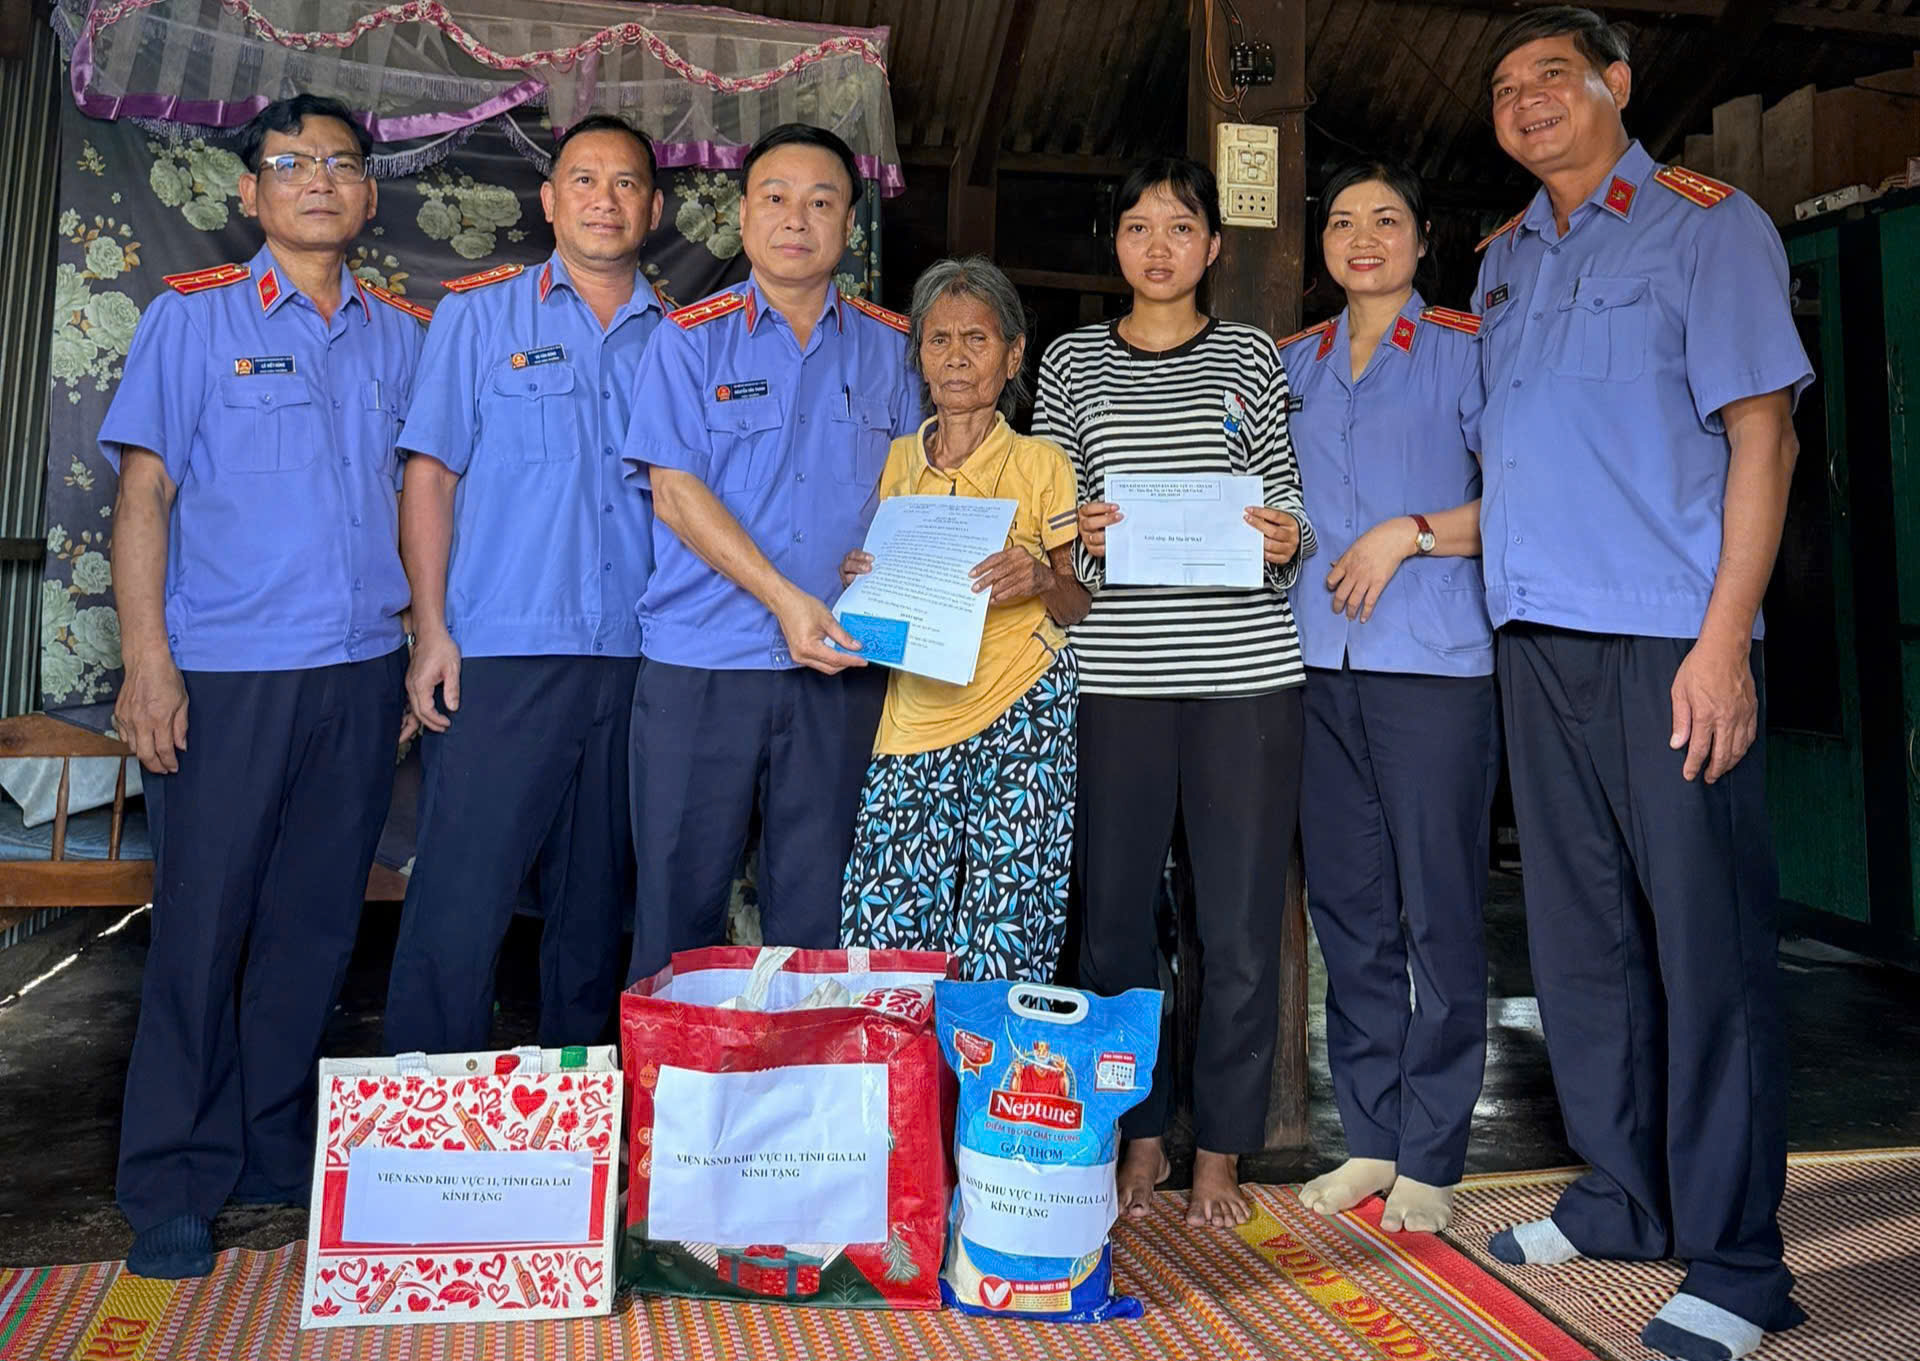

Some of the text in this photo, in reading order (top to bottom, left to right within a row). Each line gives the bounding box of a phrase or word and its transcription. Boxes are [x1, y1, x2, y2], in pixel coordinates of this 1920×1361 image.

[995, 1095, 1076, 1125] Neptune
[677, 1154, 701, 1165] VIỆN
[703, 1157, 731, 1166] KSND
[734, 1154, 756, 1163] KHU
[759, 1153, 782, 1165] VỰC
[784, 1153, 797, 1163] 11,
[827, 1153, 846, 1162] GIA
[848, 1153, 867, 1162] LAI
[378, 1173, 402, 1185] VIỆN
[405, 1174, 433, 1185] KSND
[435, 1175, 459, 1185] KHU
[461, 1176, 485, 1186] VỰC
[487, 1177, 500, 1187] 11,
[531, 1177, 550, 1186] GIA
[553, 1177, 571, 1186] LAI
[741, 1168, 800, 1180] KÍNH TẶNG
[442, 1191, 503, 1203] KÍNH TẶNG
[985, 1183, 1007, 1196] KHU
[1009, 1188, 1032, 1201] VỰC
[1034, 1192, 1047, 1203] 11,
[1076, 1195, 1093, 1205] GIA
[1095, 1193, 1108, 1204] LAI
[991, 1200, 1049, 1219] KÍNH TẶNG
